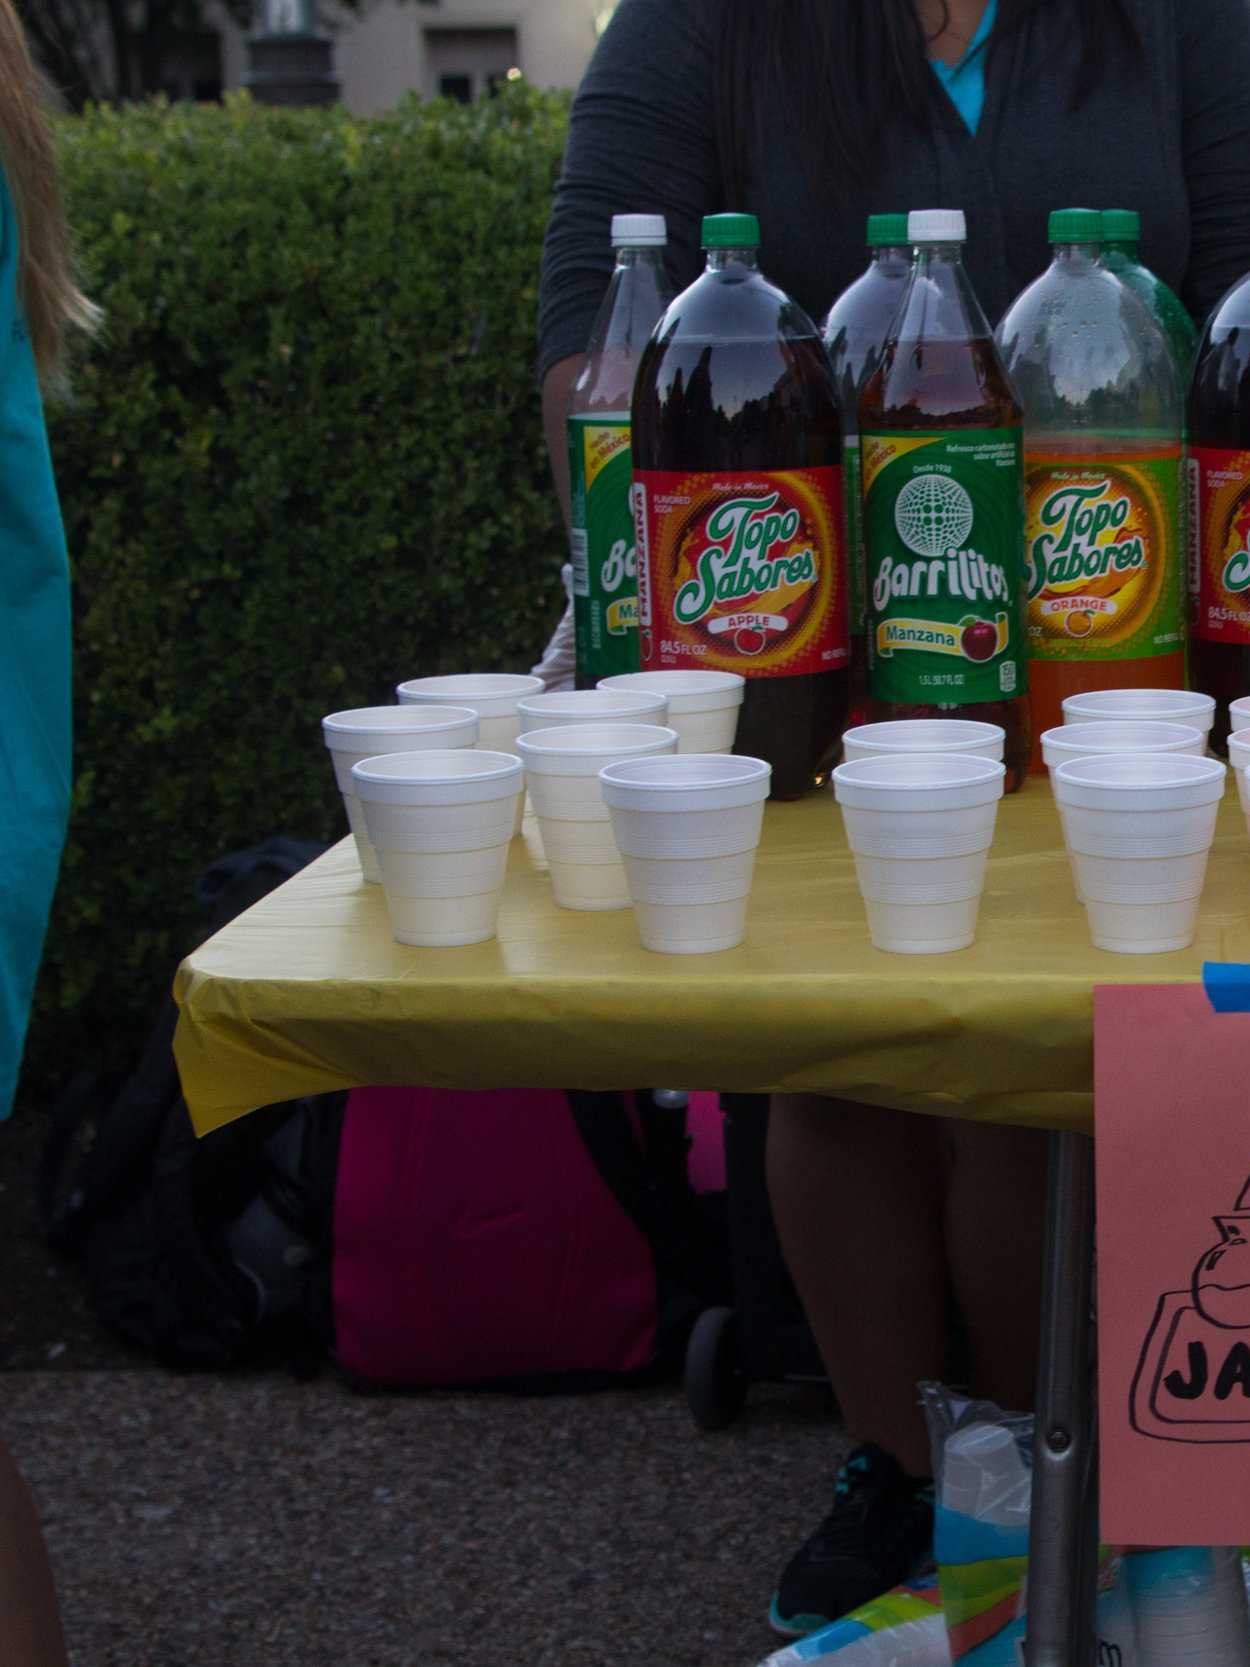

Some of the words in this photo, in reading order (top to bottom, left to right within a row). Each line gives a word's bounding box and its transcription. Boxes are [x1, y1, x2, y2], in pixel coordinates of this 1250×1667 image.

[707, 491, 799, 569] Topo
[1041, 480, 1128, 554] Topo
[674, 547, 815, 624] Sabores
[1024, 533, 1144, 600] Sabores
[728, 616, 770, 628] APPLE
[886, 625, 955, 647] Manzana
[1050, 600, 1109, 612] ORANGE
